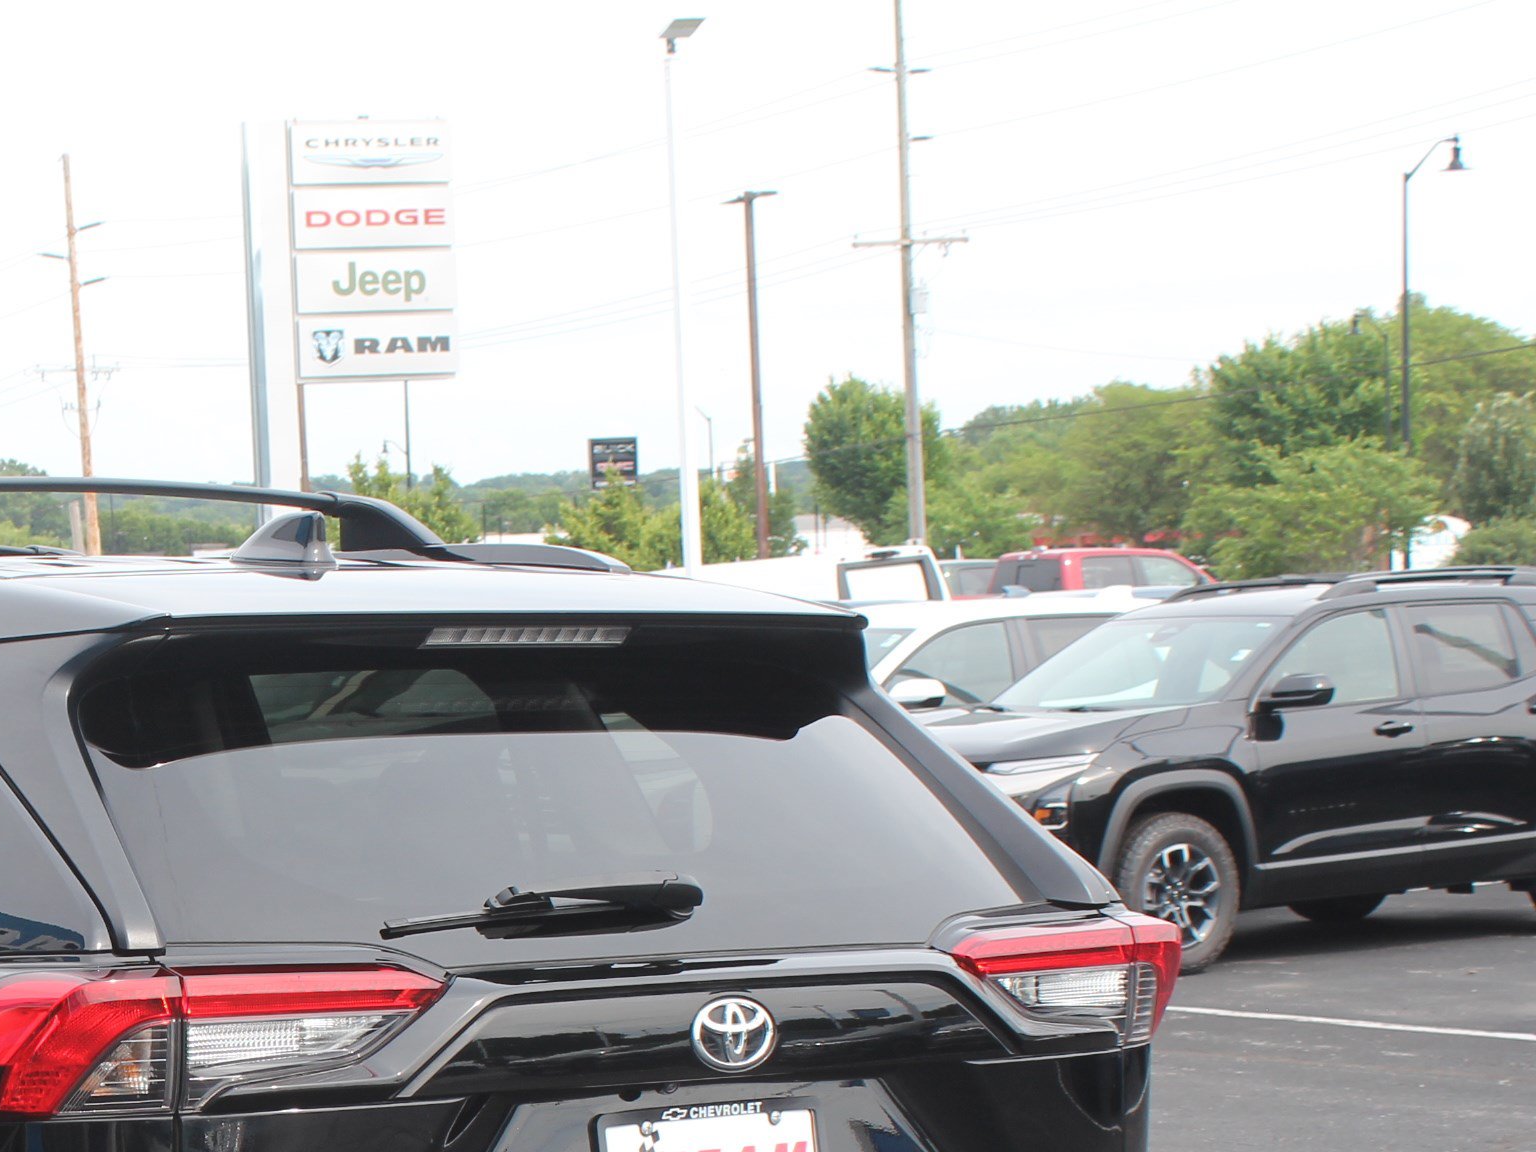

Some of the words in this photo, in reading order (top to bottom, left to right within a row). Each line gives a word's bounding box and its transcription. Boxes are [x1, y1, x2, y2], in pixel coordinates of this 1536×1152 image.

[304, 136, 441, 149] CHRYSLER
[304, 208, 447, 228] DODGE
[331, 261, 427, 303] Jeep
[353, 335, 451, 355] RAM
[689, 1101, 764, 1120] CHEVROLET
